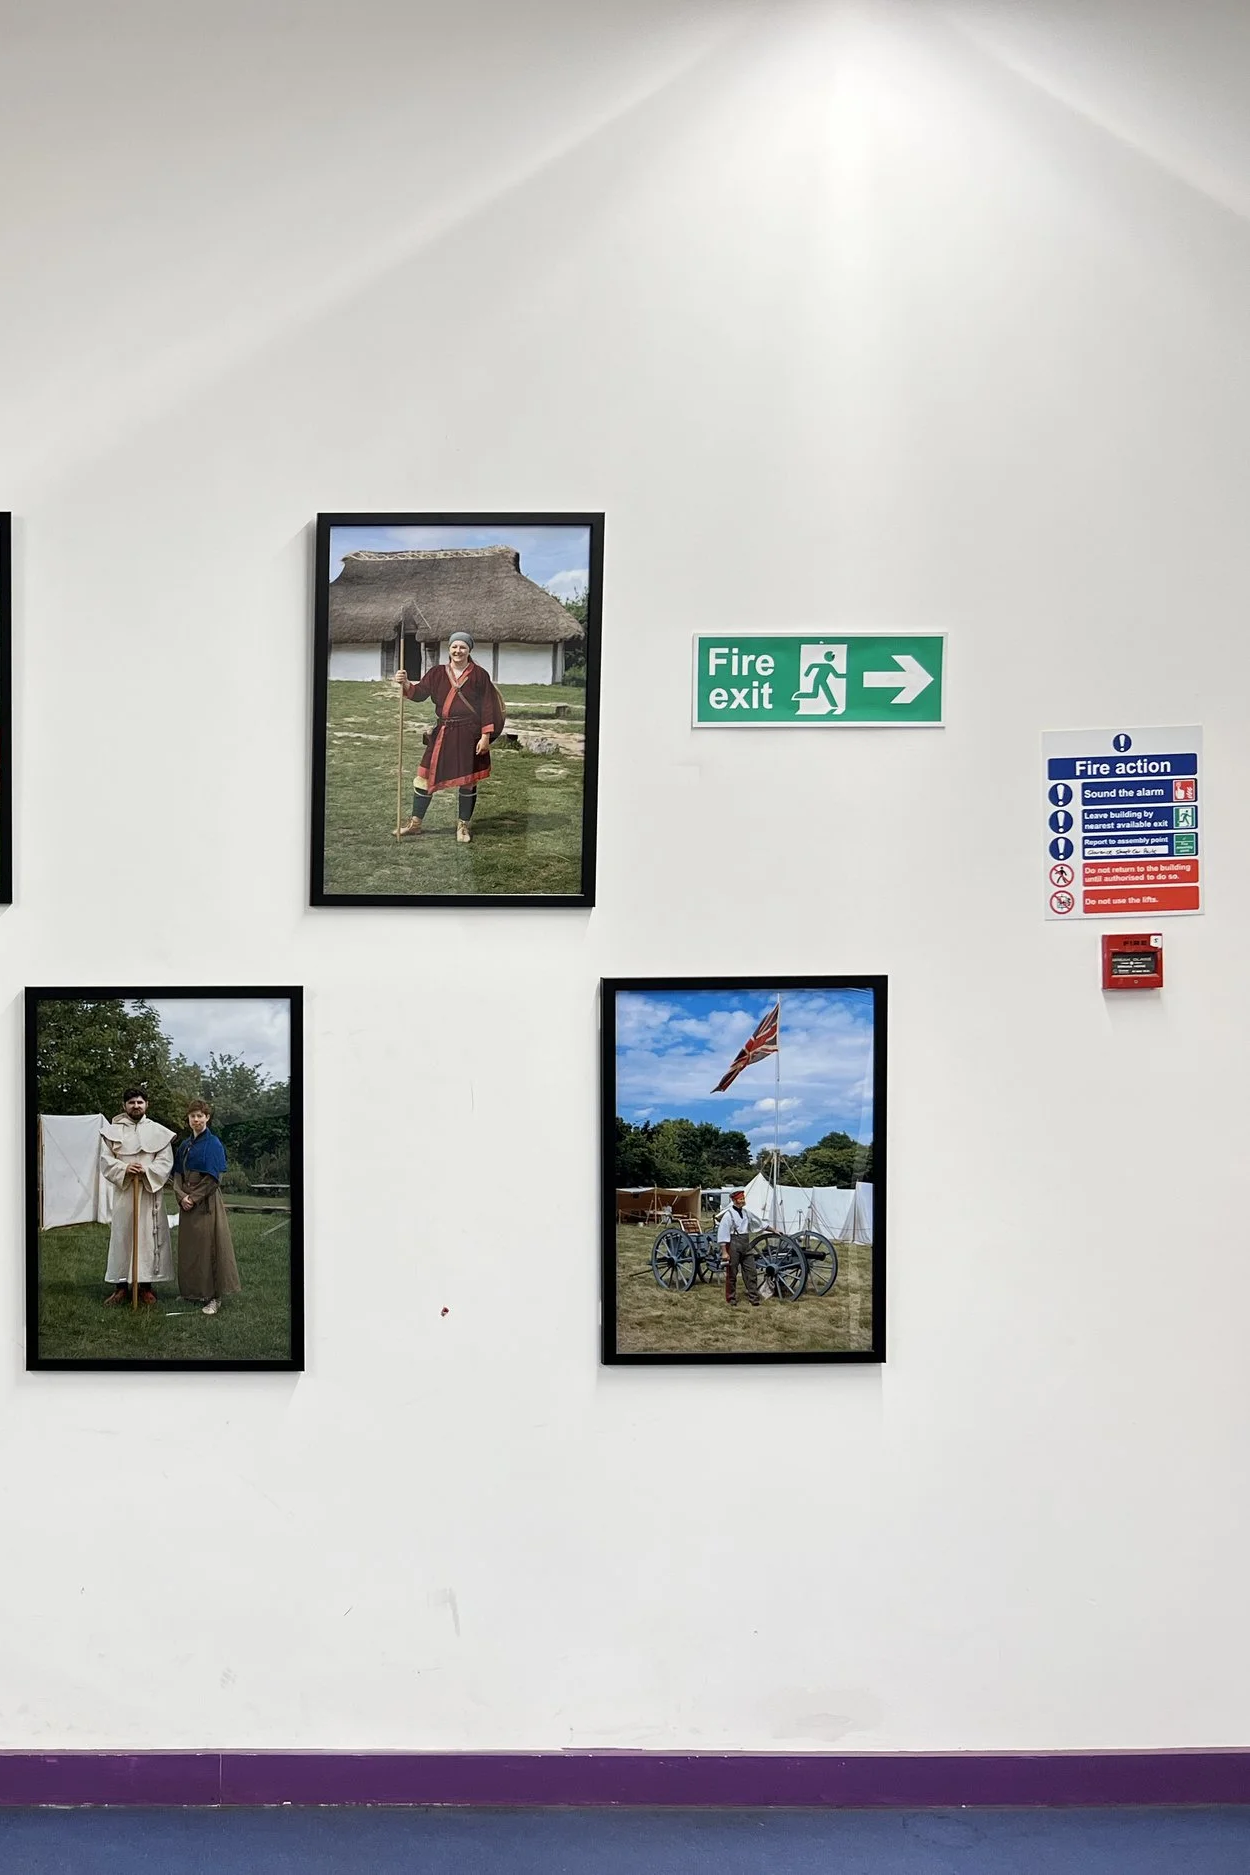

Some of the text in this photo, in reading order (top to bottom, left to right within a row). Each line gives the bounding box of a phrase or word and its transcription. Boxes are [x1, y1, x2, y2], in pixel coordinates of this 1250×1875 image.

[708, 648, 775, 676] Fire
[708, 682, 774, 710] exit
[1075, 758, 1171, 776] Fire action
[1084, 788, 1164, 798] Sound the alarm
[1110, 810, 1142, 819] building
[1144, 810, 1154, 819] by
[1084, 838, 1108, 846] Report
[1117, 837, 1150, 845] assembly
[1150, 836, 1168, 845] point
[1160, 864, 1191, 872] building
[1104, 874, 1145, 882] authorised
